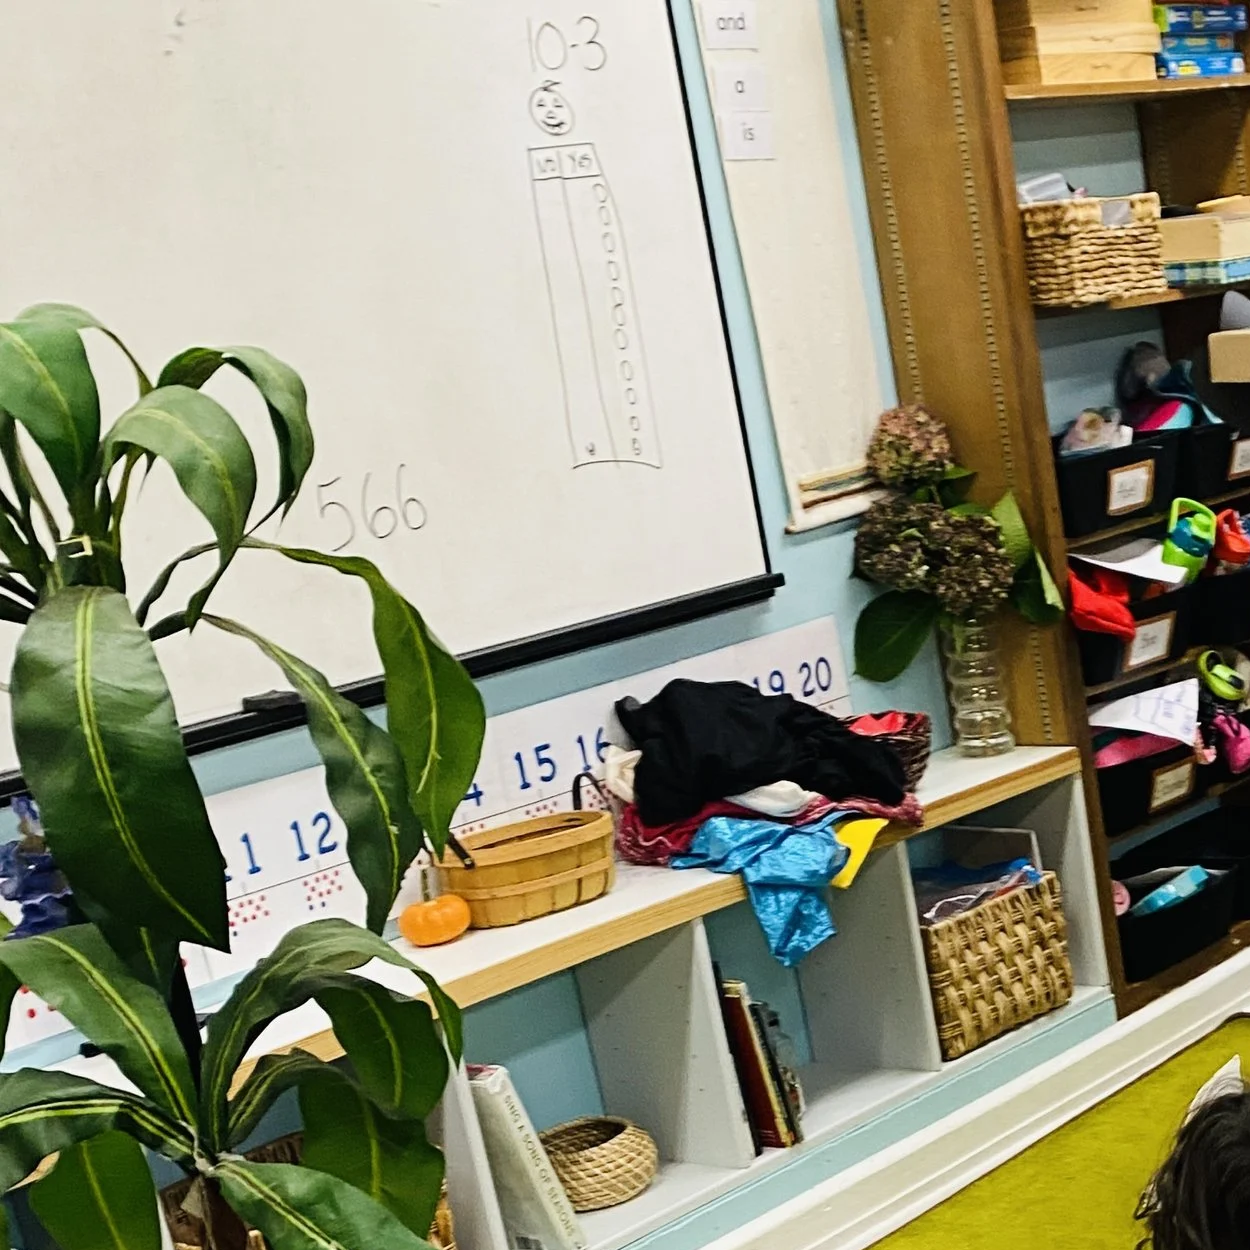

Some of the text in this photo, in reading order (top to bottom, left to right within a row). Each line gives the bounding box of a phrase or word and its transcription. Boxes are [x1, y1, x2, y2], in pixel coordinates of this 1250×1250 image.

[526, 15, 607, 74] 10-3
[716, 12, 746, 31] and
[735, 80, 745, 93] a
[741, 121, 755, 141] is
[316, 463, 428, 552] 566
[290, 811, 338, 861] 12
[514, 743, 557, 790] 15
[798, 656, 832, 698] 20
[504, 1093, 522, 1123] SING
[523, 1133, 543, 1168] SONG
[538, 1167, 551, 1184] OF
[547, 1186, 577, 1237] SEASONS
